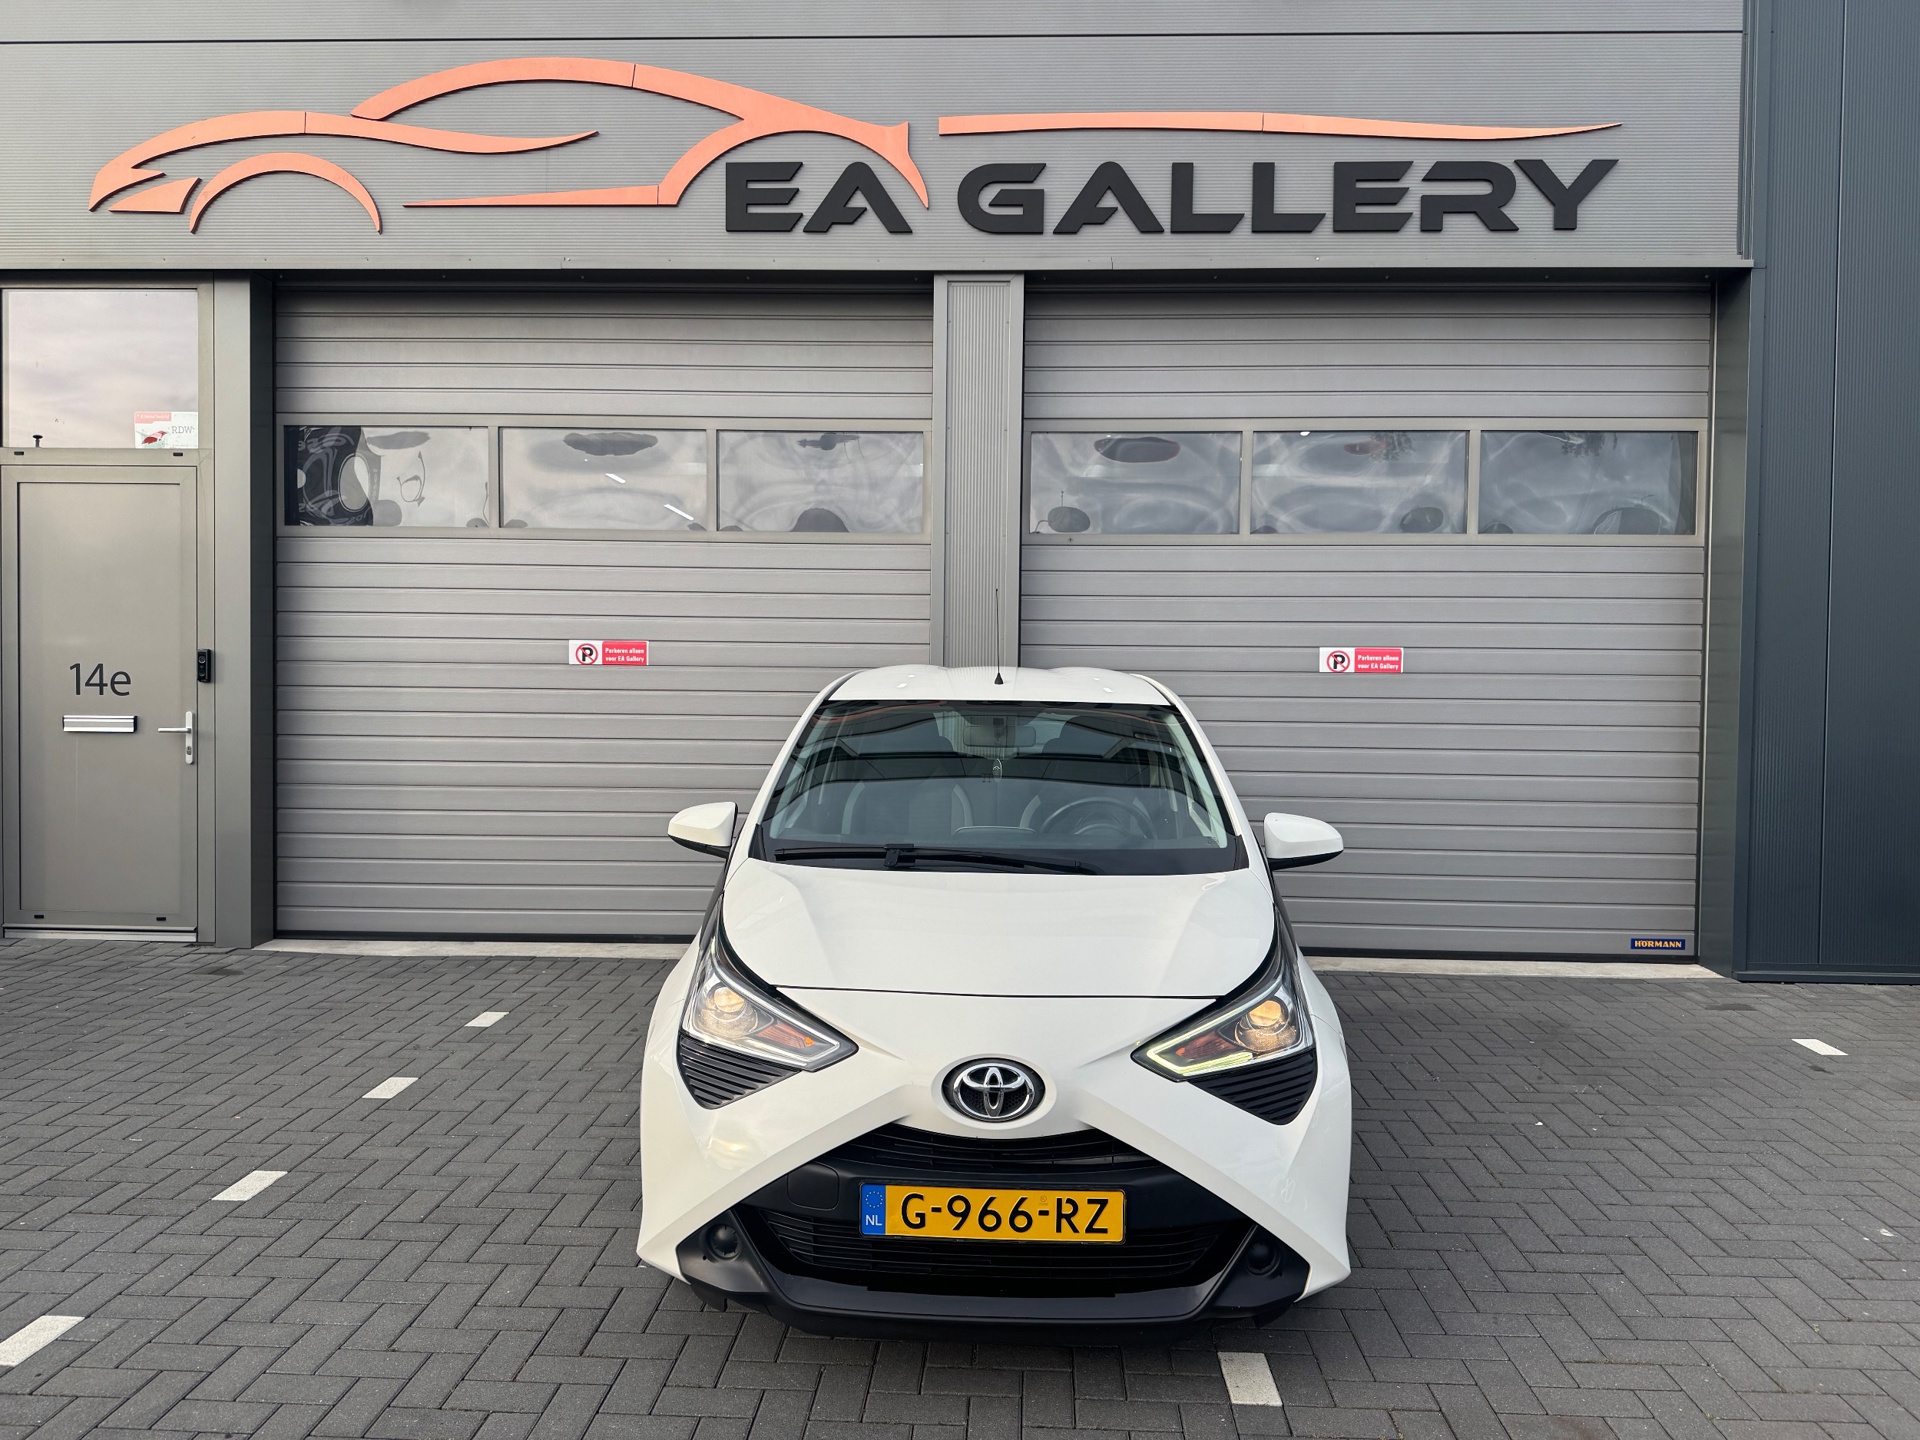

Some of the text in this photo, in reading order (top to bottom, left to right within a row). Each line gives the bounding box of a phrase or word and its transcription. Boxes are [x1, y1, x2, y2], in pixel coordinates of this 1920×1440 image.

[726, 160, 1620, 236] EA GALLERY
[171, 425, 193, 434] RDW
[626, 655, 645, 663] Gallery
[69, 662, 132, 697] 14e
[866, 1214, 883, 1226] NL
[901, 1193, 1109, 1234] G-966-RZ
